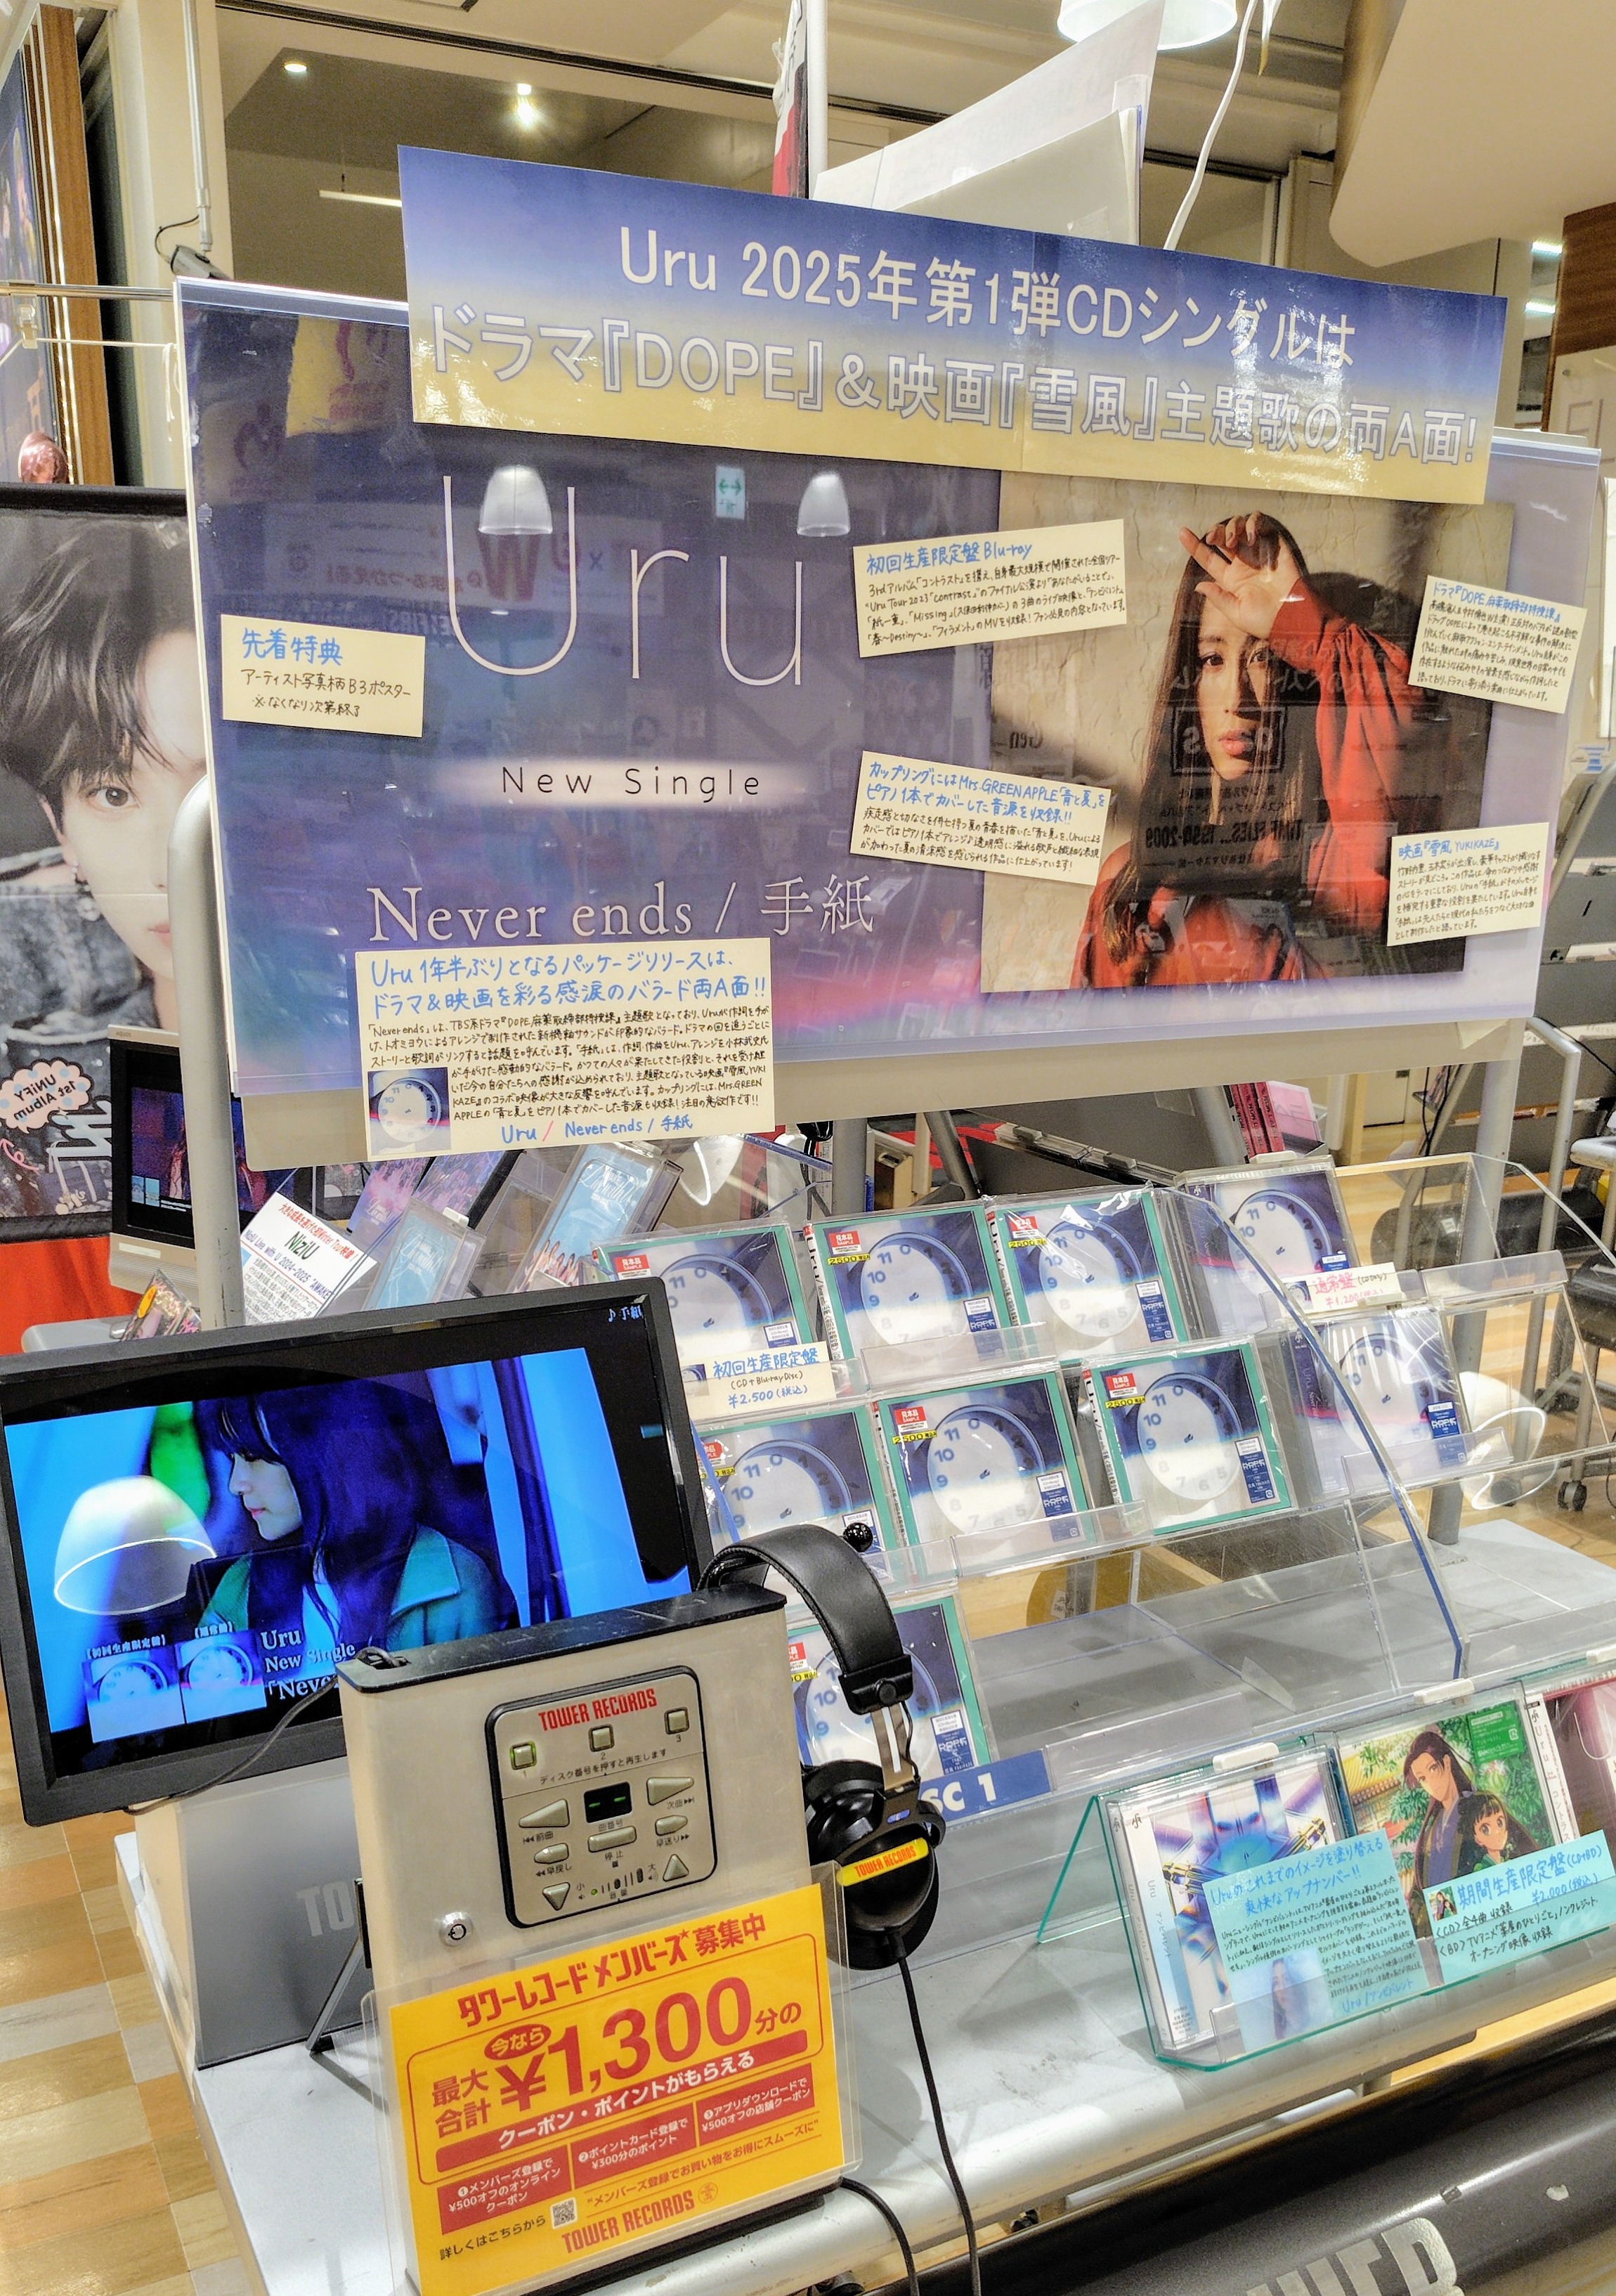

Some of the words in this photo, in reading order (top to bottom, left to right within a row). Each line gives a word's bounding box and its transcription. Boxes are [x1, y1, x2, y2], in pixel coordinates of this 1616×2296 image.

[620, 226, 716, 292] Uru
[741, 241, 1356, 368] 2025年第1弾CDシングルは
[443, 475, 802, 686] Uru
[242, 628, 344, 666] 先着特典
[502, 766, 592, 795] New
[625, 768, 760, 803] Single
[366, 887, 547, 942] Never
[572, 881, 693, 937] ends
[761, 872, 875, 937] 手紙
[371, 959, 413, 987] Uru
[501, 1124, 537, 1145] Uru
[565, 1122, 608, 1138] Never
[611, 1118, 643, 1134] ends
[660, 1113, 693, 1131] 手紙
[285, 1231, 320, 1260] NiziU
[712, 1347, 820, 1380] 初回生産限定盤
[261, 1628, 302, 1650] Uru
[266, 1653, 301, 1673] New
[308, 1642, 356, 1667] Single
[538, 1699, 590, 1732] TOWER
[592, 1688, 658, 1720] RECORDS
[540, 1748, 667, 1785] ディスク番号を押すと再生します
[977, 1772, 998, 1802] 1
[1552, 1791, 1571, 1842] コントラス
[854, 1857, 884, 1878] TOWER
[882, 1844, 918, 1870] RECORDS
[694, 1912, 767, 1957] 募集中
[490, 2027, 546, 2058] 今なら
[431, 2068, 490, 2108] 最大
[498, 2050, 755, 2150] クーポン・ポイントがもらえる
[434, 2097, 492, 2139] 合計
[486, 2191, 528, 2214] クーポン
[439, 2214, 547, 2261] 詳しくはこちらから
[561, 2216, 620, 2254] TOWER
[623, 2189, 696, 2233] RECORDS
